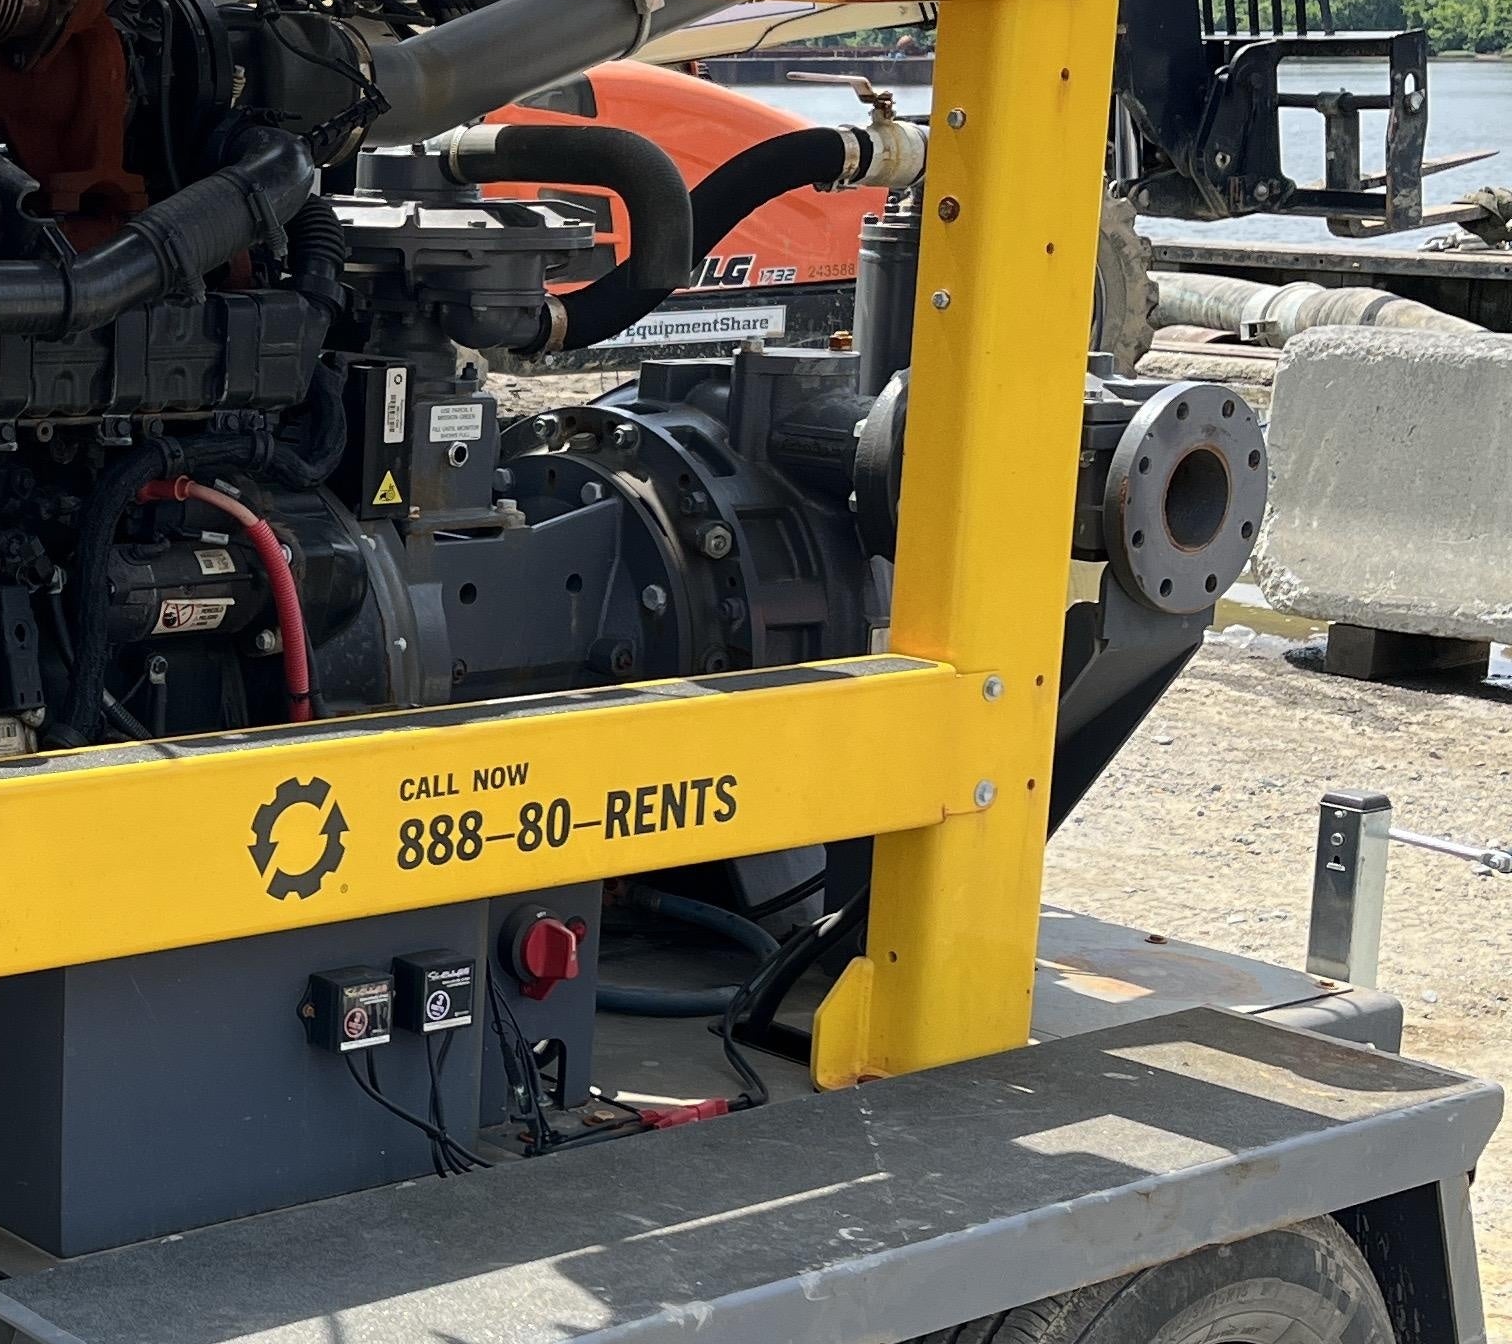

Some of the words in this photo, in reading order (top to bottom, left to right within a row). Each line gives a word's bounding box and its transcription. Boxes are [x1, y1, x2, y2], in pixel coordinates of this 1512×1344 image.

[759, 268, 796, 282] 1732
[808, 263, 855, 278] 243588
[626, 317, 769, 339] EquipmentShare
[399, 773, 460, 801] CALL
[473, 762, 529, 792] NOW
